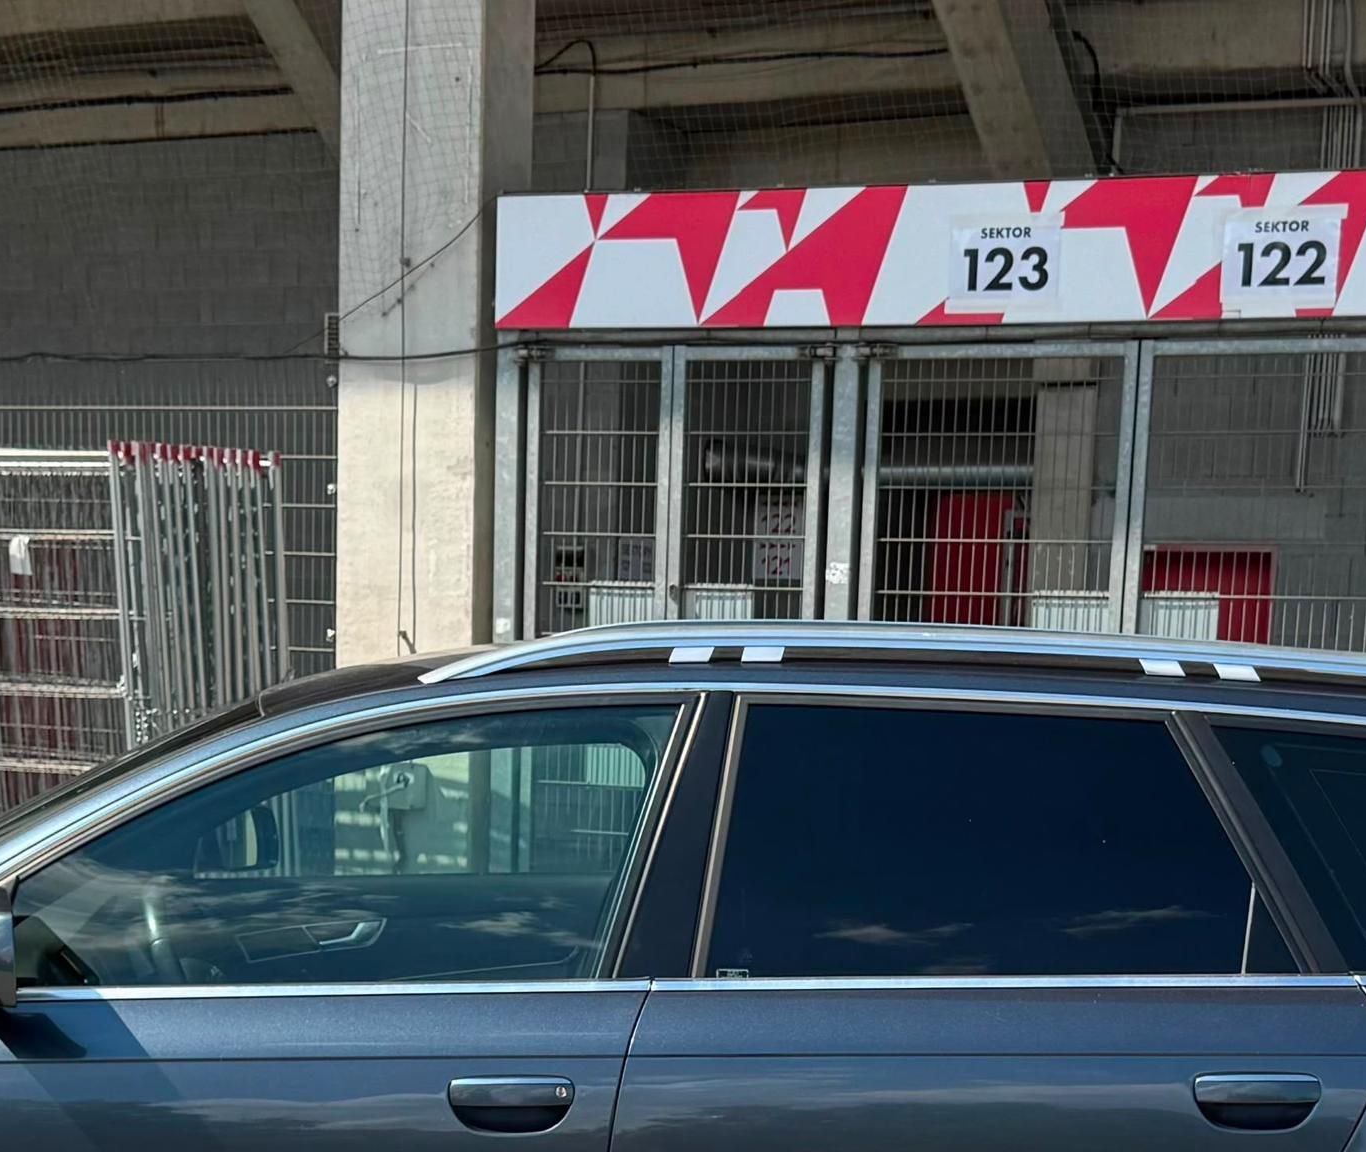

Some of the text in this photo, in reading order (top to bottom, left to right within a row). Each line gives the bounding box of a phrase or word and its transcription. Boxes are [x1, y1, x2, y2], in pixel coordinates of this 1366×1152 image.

[980, 226, 1032, 240] SEKTOR
[1254, 219, 1310, 234] SEKTOR
[963, 246, 1049, 292] 123
[1237, 240, 1328, 288] 122
